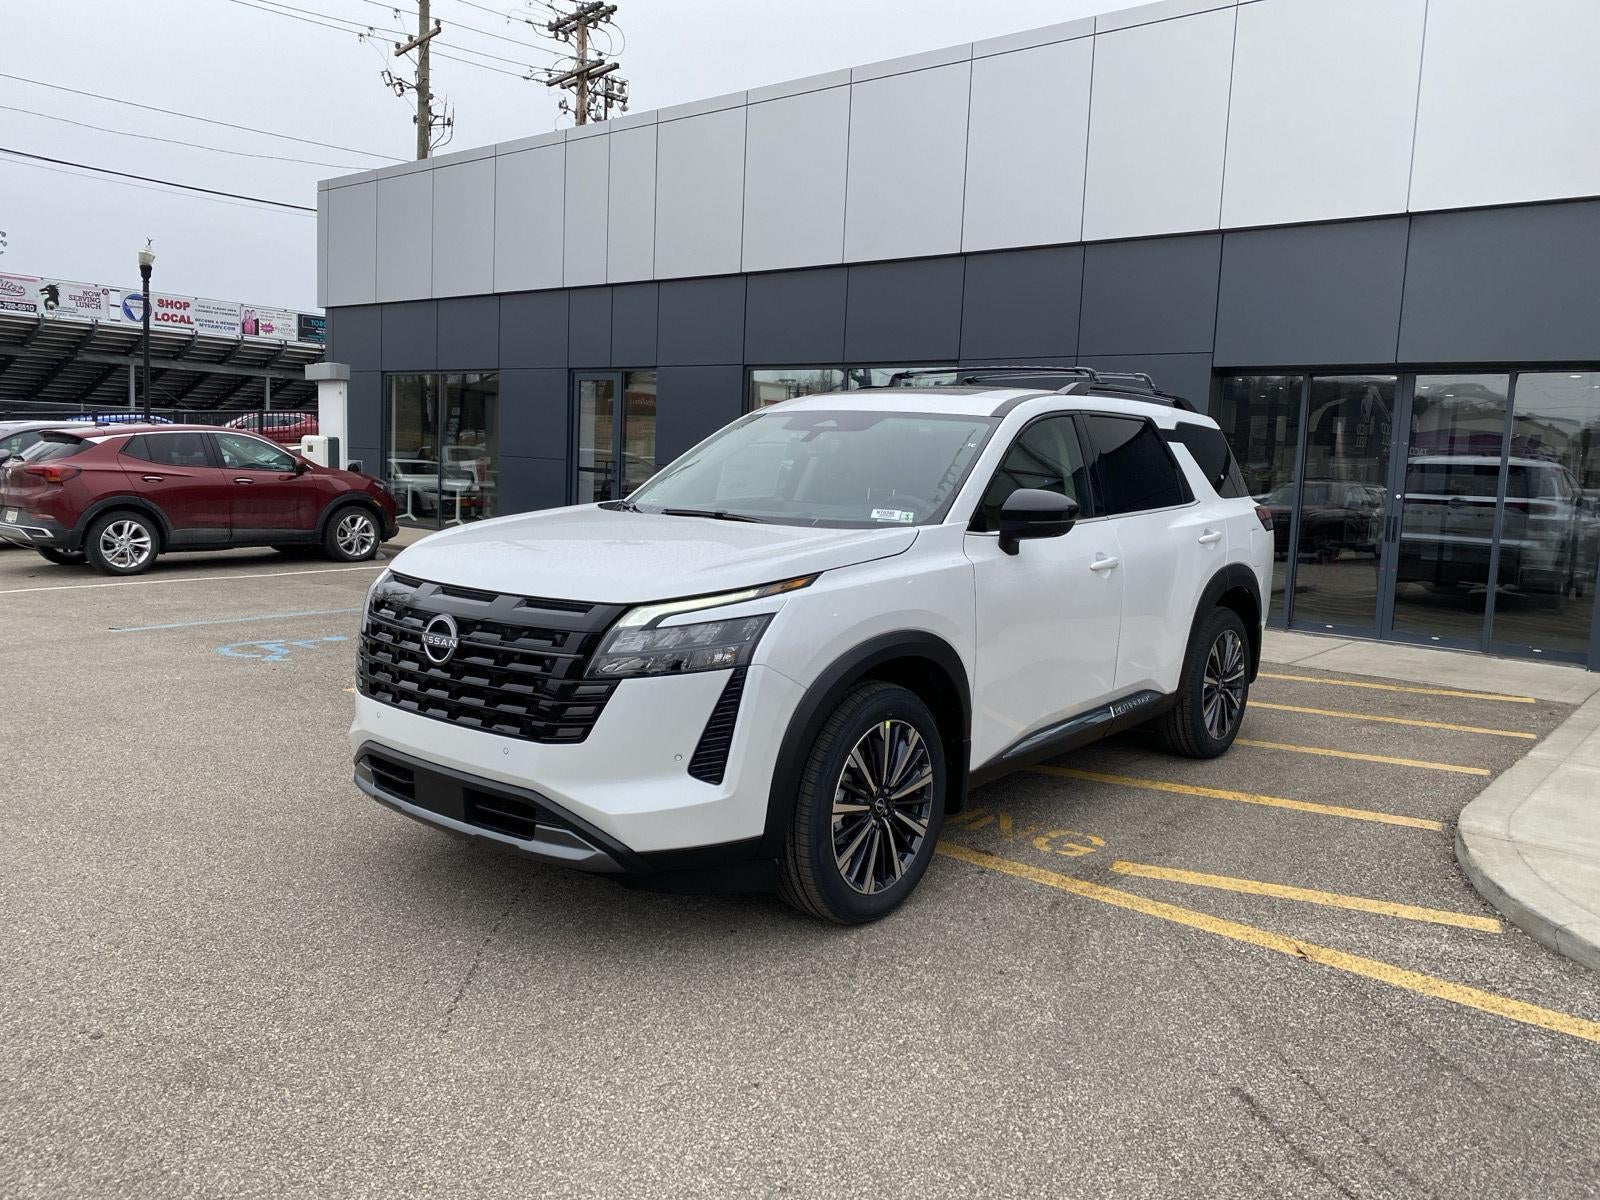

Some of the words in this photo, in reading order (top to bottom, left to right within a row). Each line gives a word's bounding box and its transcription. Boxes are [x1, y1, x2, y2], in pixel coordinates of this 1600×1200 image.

[68, 294, 101, 304] SERVING
[82, 290, 101, 298] NOW
[75, 301, 102, 310] LUNCH
[157, 298, 190, 311] SHOP
[154, 312, 194, 325] LOCAL
[421, 633, 458, 648] NISSAN
